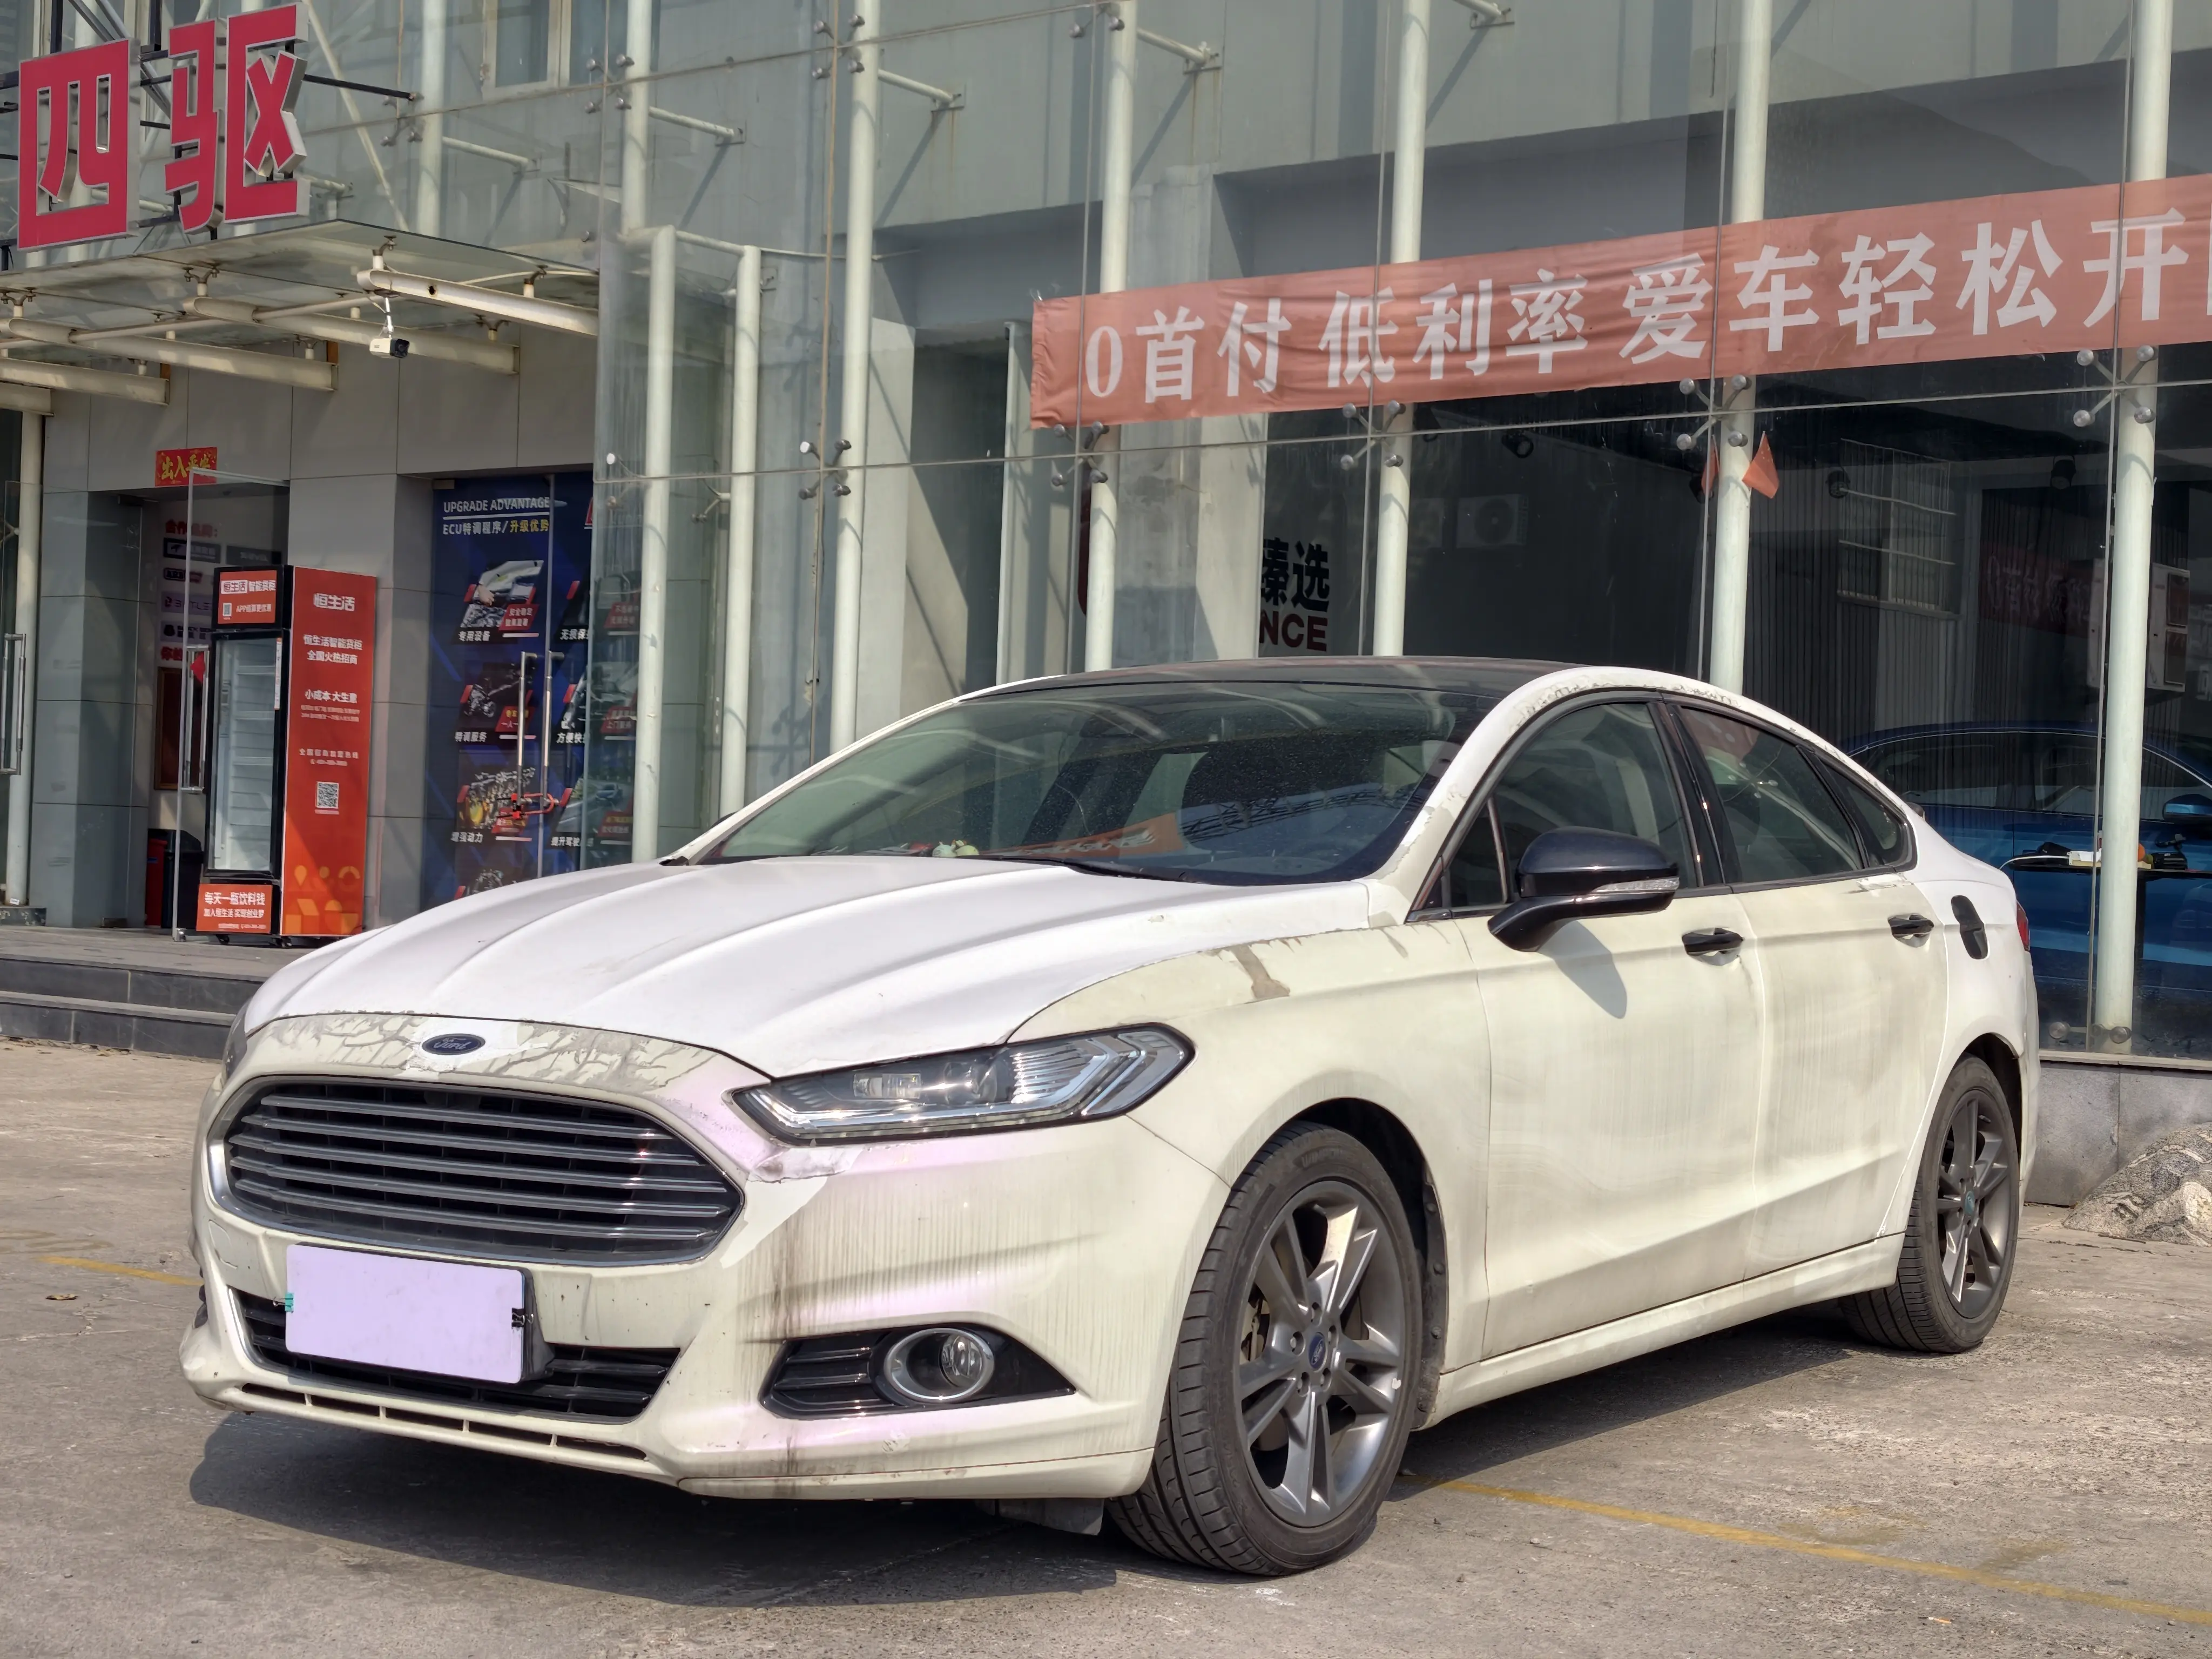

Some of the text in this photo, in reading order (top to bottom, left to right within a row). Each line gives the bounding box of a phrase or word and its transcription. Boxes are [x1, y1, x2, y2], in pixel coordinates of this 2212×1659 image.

[18, 2, 309, 250] 四驱
[1084, 203, 2212, 404] 0首付 低利率 爱车轻松开
[443, 496, 550, 513] UPGRADE ADVANTAGE
[313, 593, 355, 612] 恒生活
[1259, 609, 1328, 652] NCE
[433, 1037, 472, 1050] Ford
